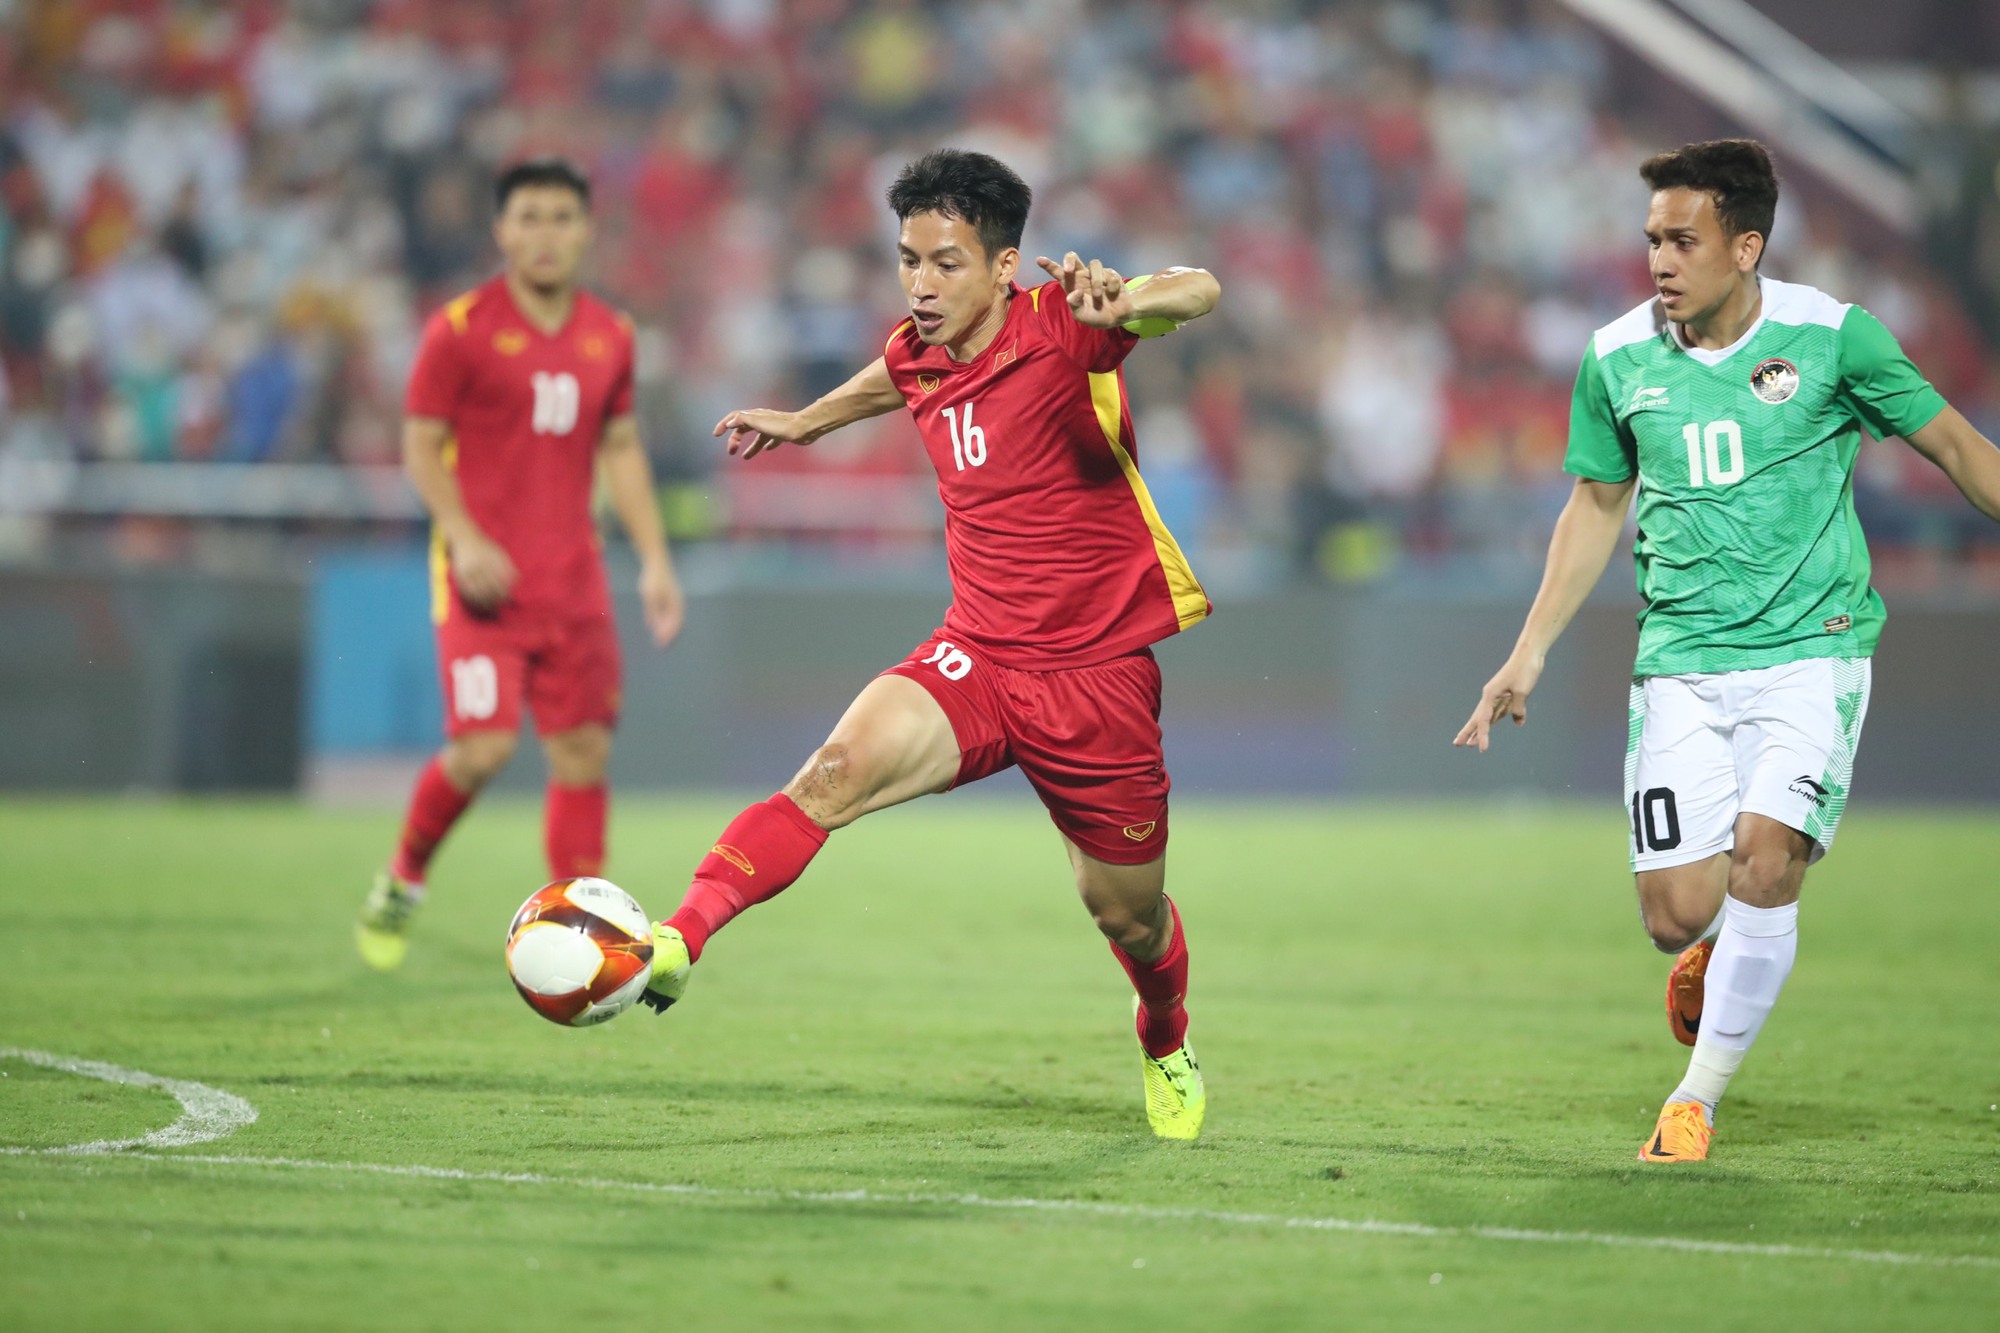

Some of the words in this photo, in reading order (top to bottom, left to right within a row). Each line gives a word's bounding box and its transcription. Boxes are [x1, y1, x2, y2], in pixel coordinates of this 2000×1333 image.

[531, 370, 580, 436] 10
[1629, 397, 1670, 410] LI-NING
[941, 402, 987, 472] 16
[1682, 419, 1744, 487] 10
[921, 641, 972, 681] 16
[1632, 786, 1681, 854] 10
[1788, 784, 1826, 808] LI-NING
